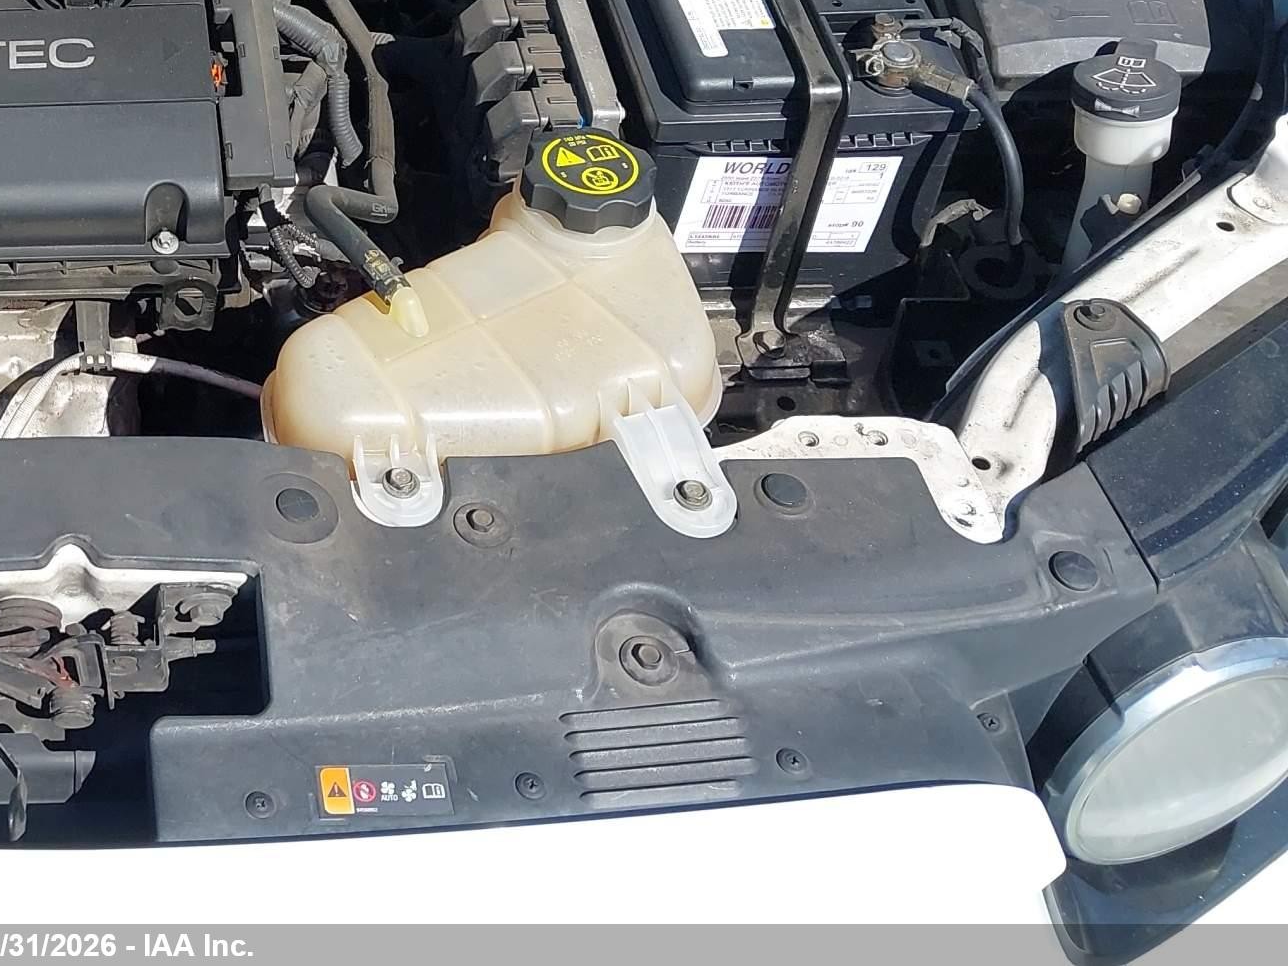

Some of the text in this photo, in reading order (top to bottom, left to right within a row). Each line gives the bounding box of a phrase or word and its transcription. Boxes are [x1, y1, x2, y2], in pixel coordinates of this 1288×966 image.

[724, 162, 791, 175] WORLD
[866, 163, 887, 172] 129
[852, 220, 864, 228] 90
[381, 794, 399, 802] AUTO
